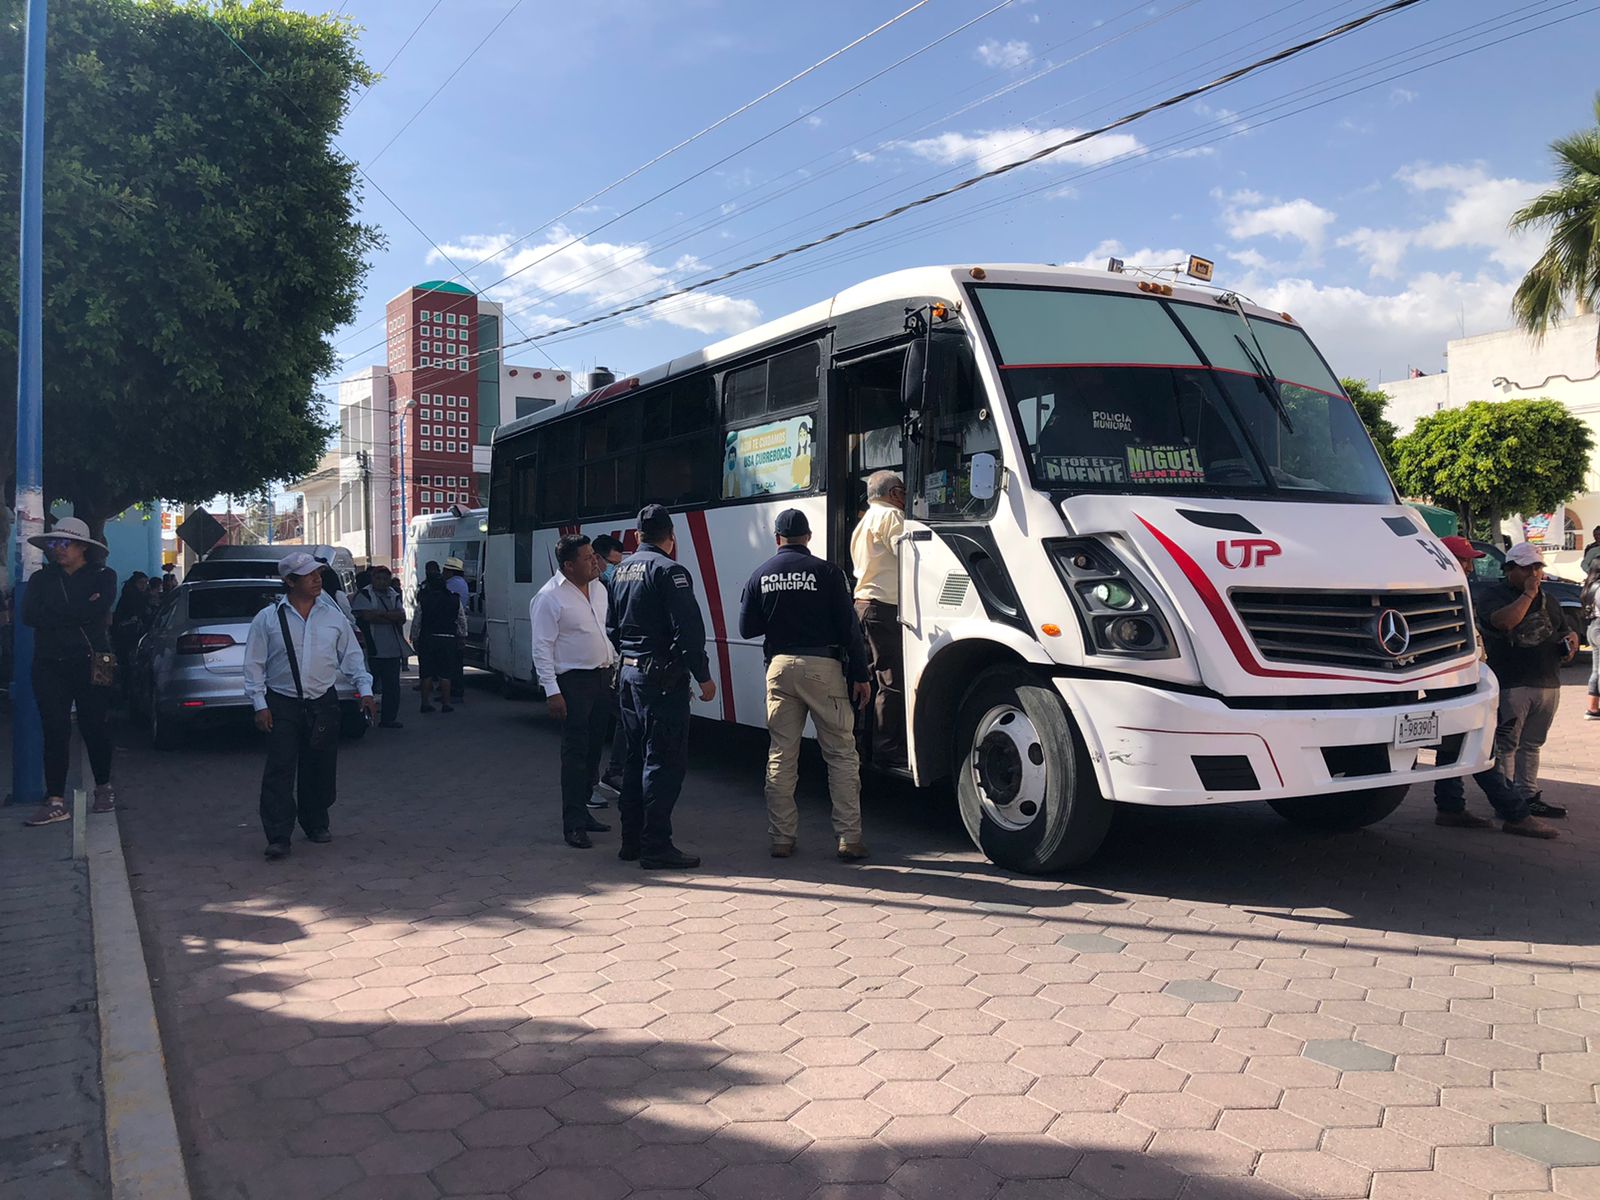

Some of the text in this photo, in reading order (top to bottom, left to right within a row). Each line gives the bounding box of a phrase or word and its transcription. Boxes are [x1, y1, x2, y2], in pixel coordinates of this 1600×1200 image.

[755, 446, 792, 465] CUBREBOCAS
[1060, 457, 1106, 467] POR EL
[1126, 446, 1204, 473] MIGUEL
[1046, 461, 1125, 483] PUENTE
[1130, 469, 1206, 479] CENTRO
[1215, 538, 1282, 569] UTP
[1415, 538, 1457, 573] 54
[760, 571, 817, 585] POLICÍA
[761, 581, 818, 594] MUNICIPAL
